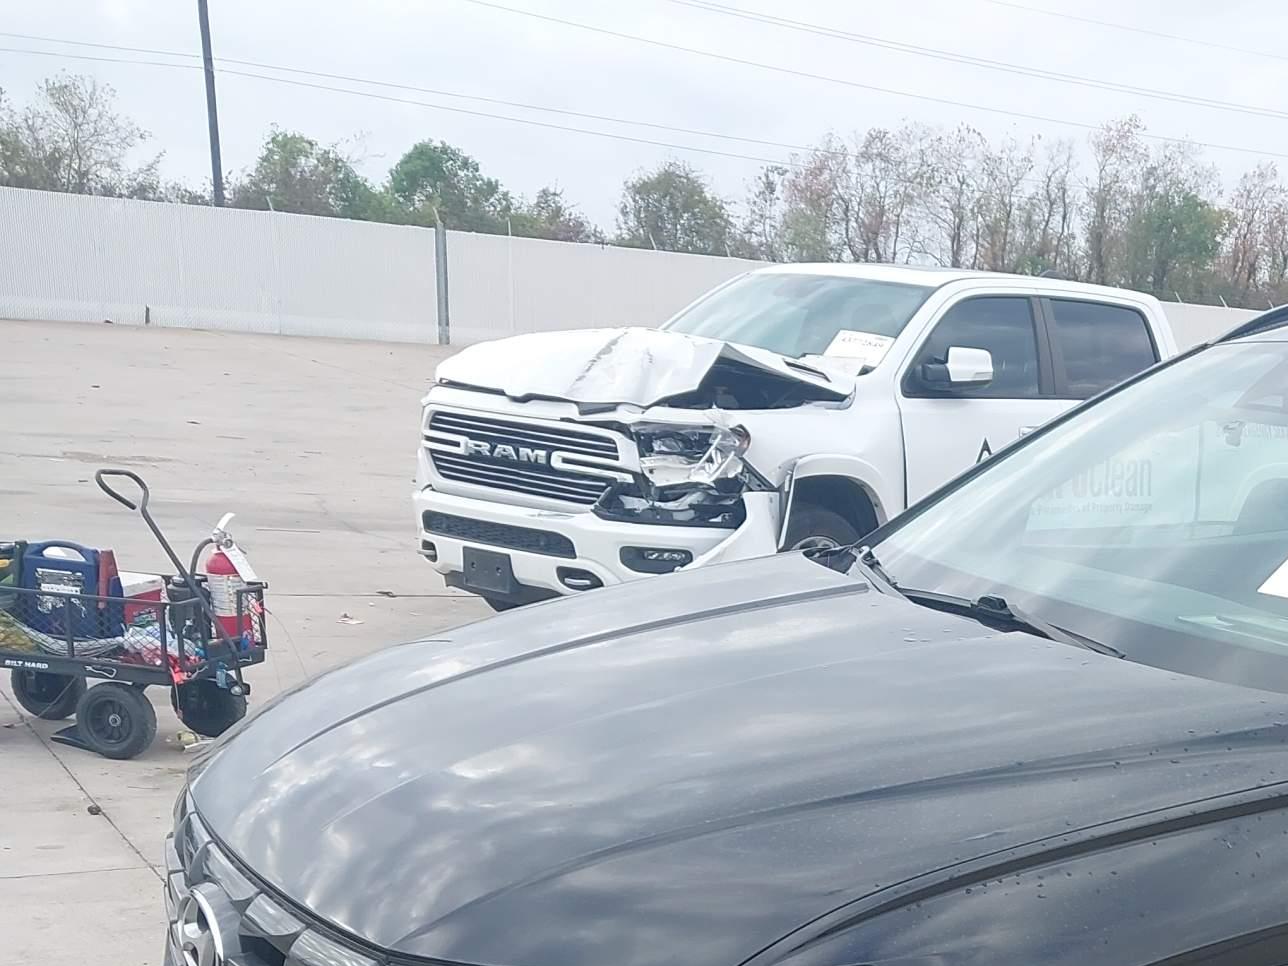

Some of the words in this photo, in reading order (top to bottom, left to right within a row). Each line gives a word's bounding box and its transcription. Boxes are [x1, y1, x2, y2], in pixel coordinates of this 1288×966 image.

[465, 436, 548, 465] RAM
[5, 659, 23, 667] BILT
[24, 661, 49, 669] HARD
